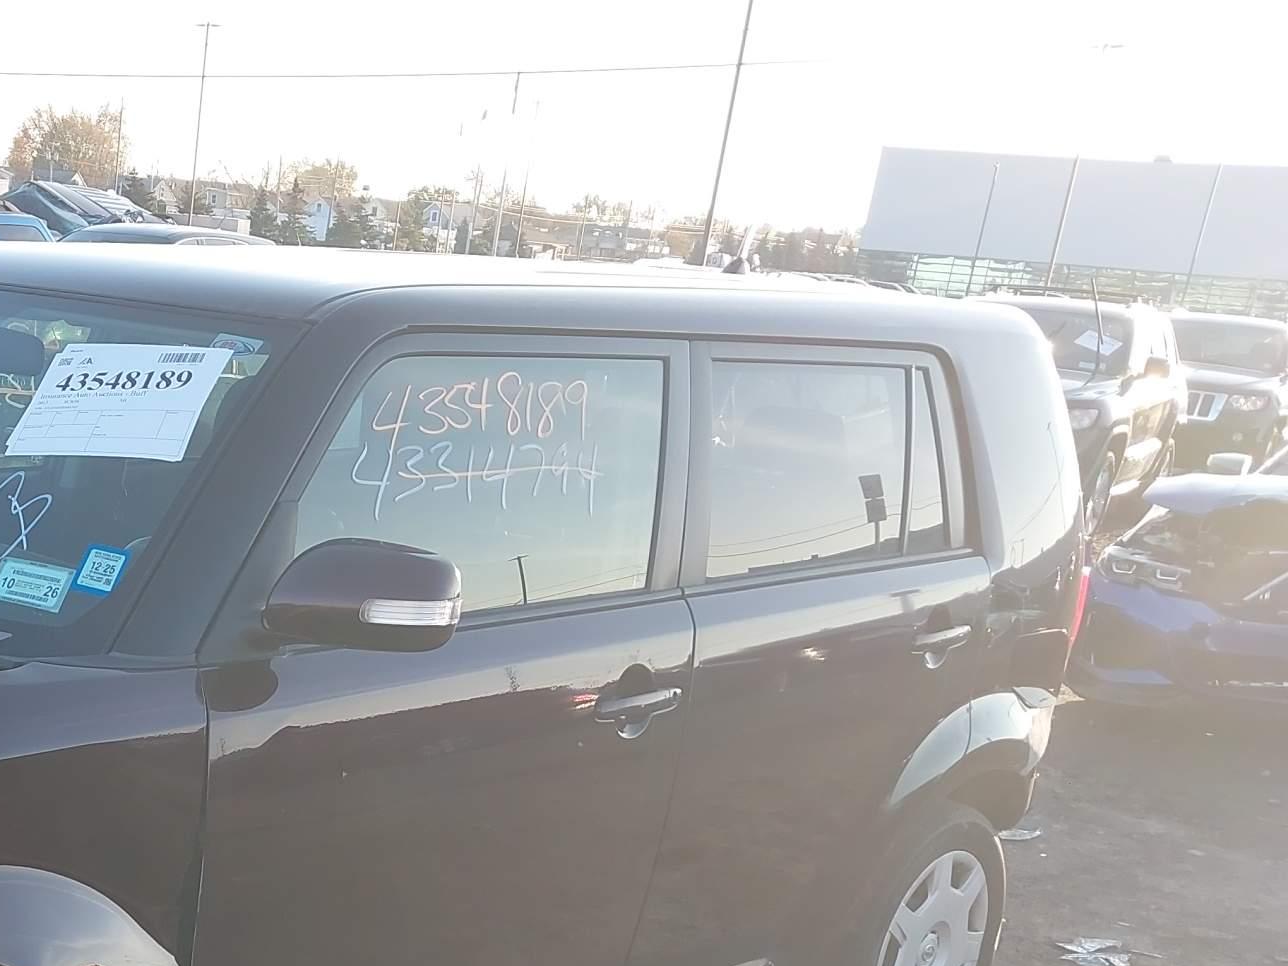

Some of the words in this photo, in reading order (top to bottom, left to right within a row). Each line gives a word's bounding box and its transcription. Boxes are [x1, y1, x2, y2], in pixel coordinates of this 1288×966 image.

[55, 370, 193, 392] 43548189
[372, 372, 588, 453] 43548189
[1, 576, 16, 589] 10
[43, 585, 60, 599] 26
